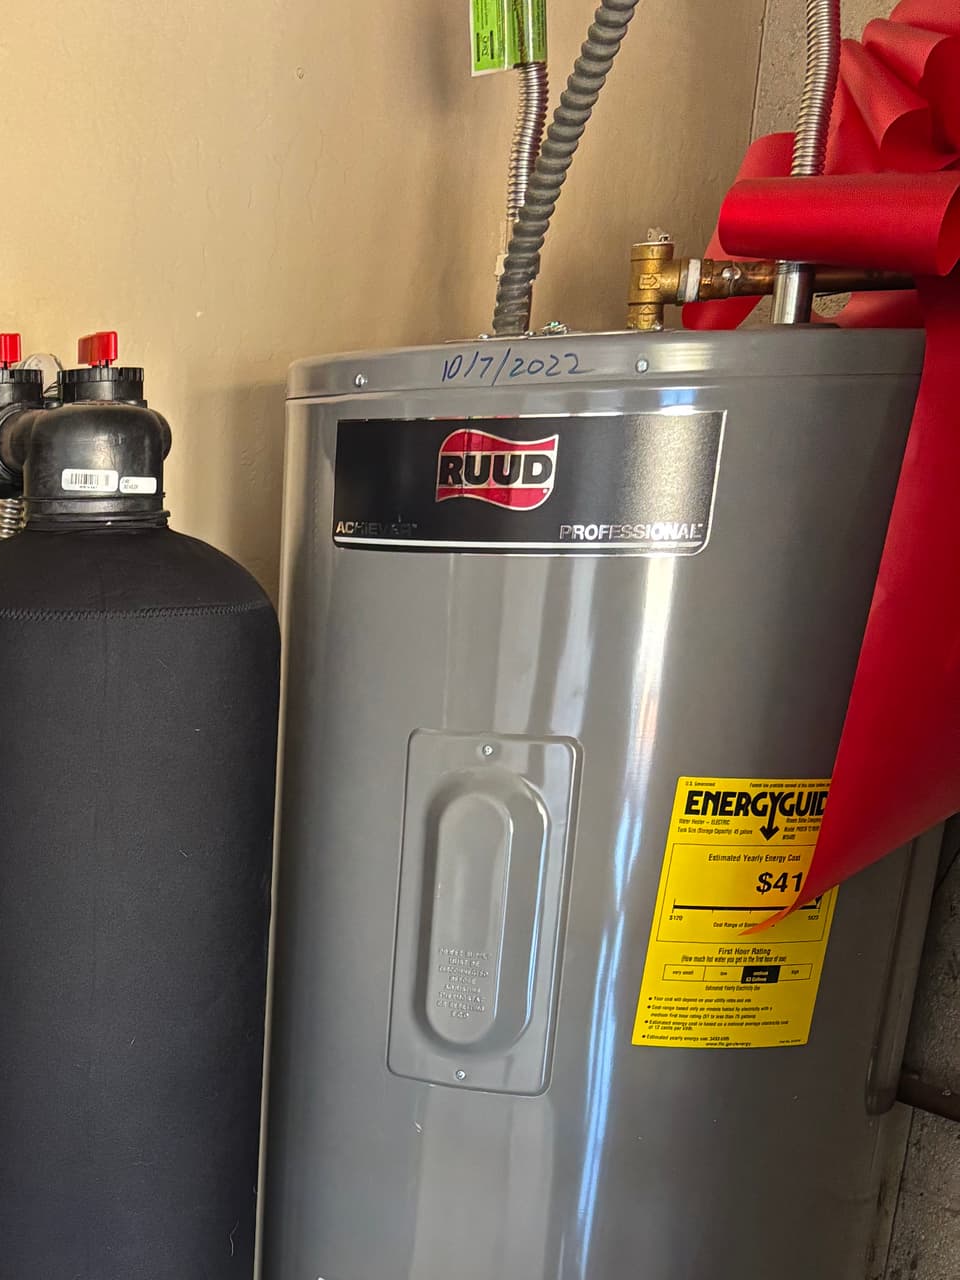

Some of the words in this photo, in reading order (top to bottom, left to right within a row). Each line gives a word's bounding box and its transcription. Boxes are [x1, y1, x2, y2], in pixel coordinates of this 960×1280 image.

[442, 348, 596, 387] 10/7/2022
[438, 454, 553, 486] RUUD
[559, 522, 703, 541] PROFESSIONAL
[684, 791, 829, 817] ENERGYGUID
[708, 853, 741, 861] Estimated
[743, 854, 763, 863] Yearly
[765, 854, 786, 863] Energy
[755, 871, 803, 895] $41
[752, 947, 771, 955] Rating
